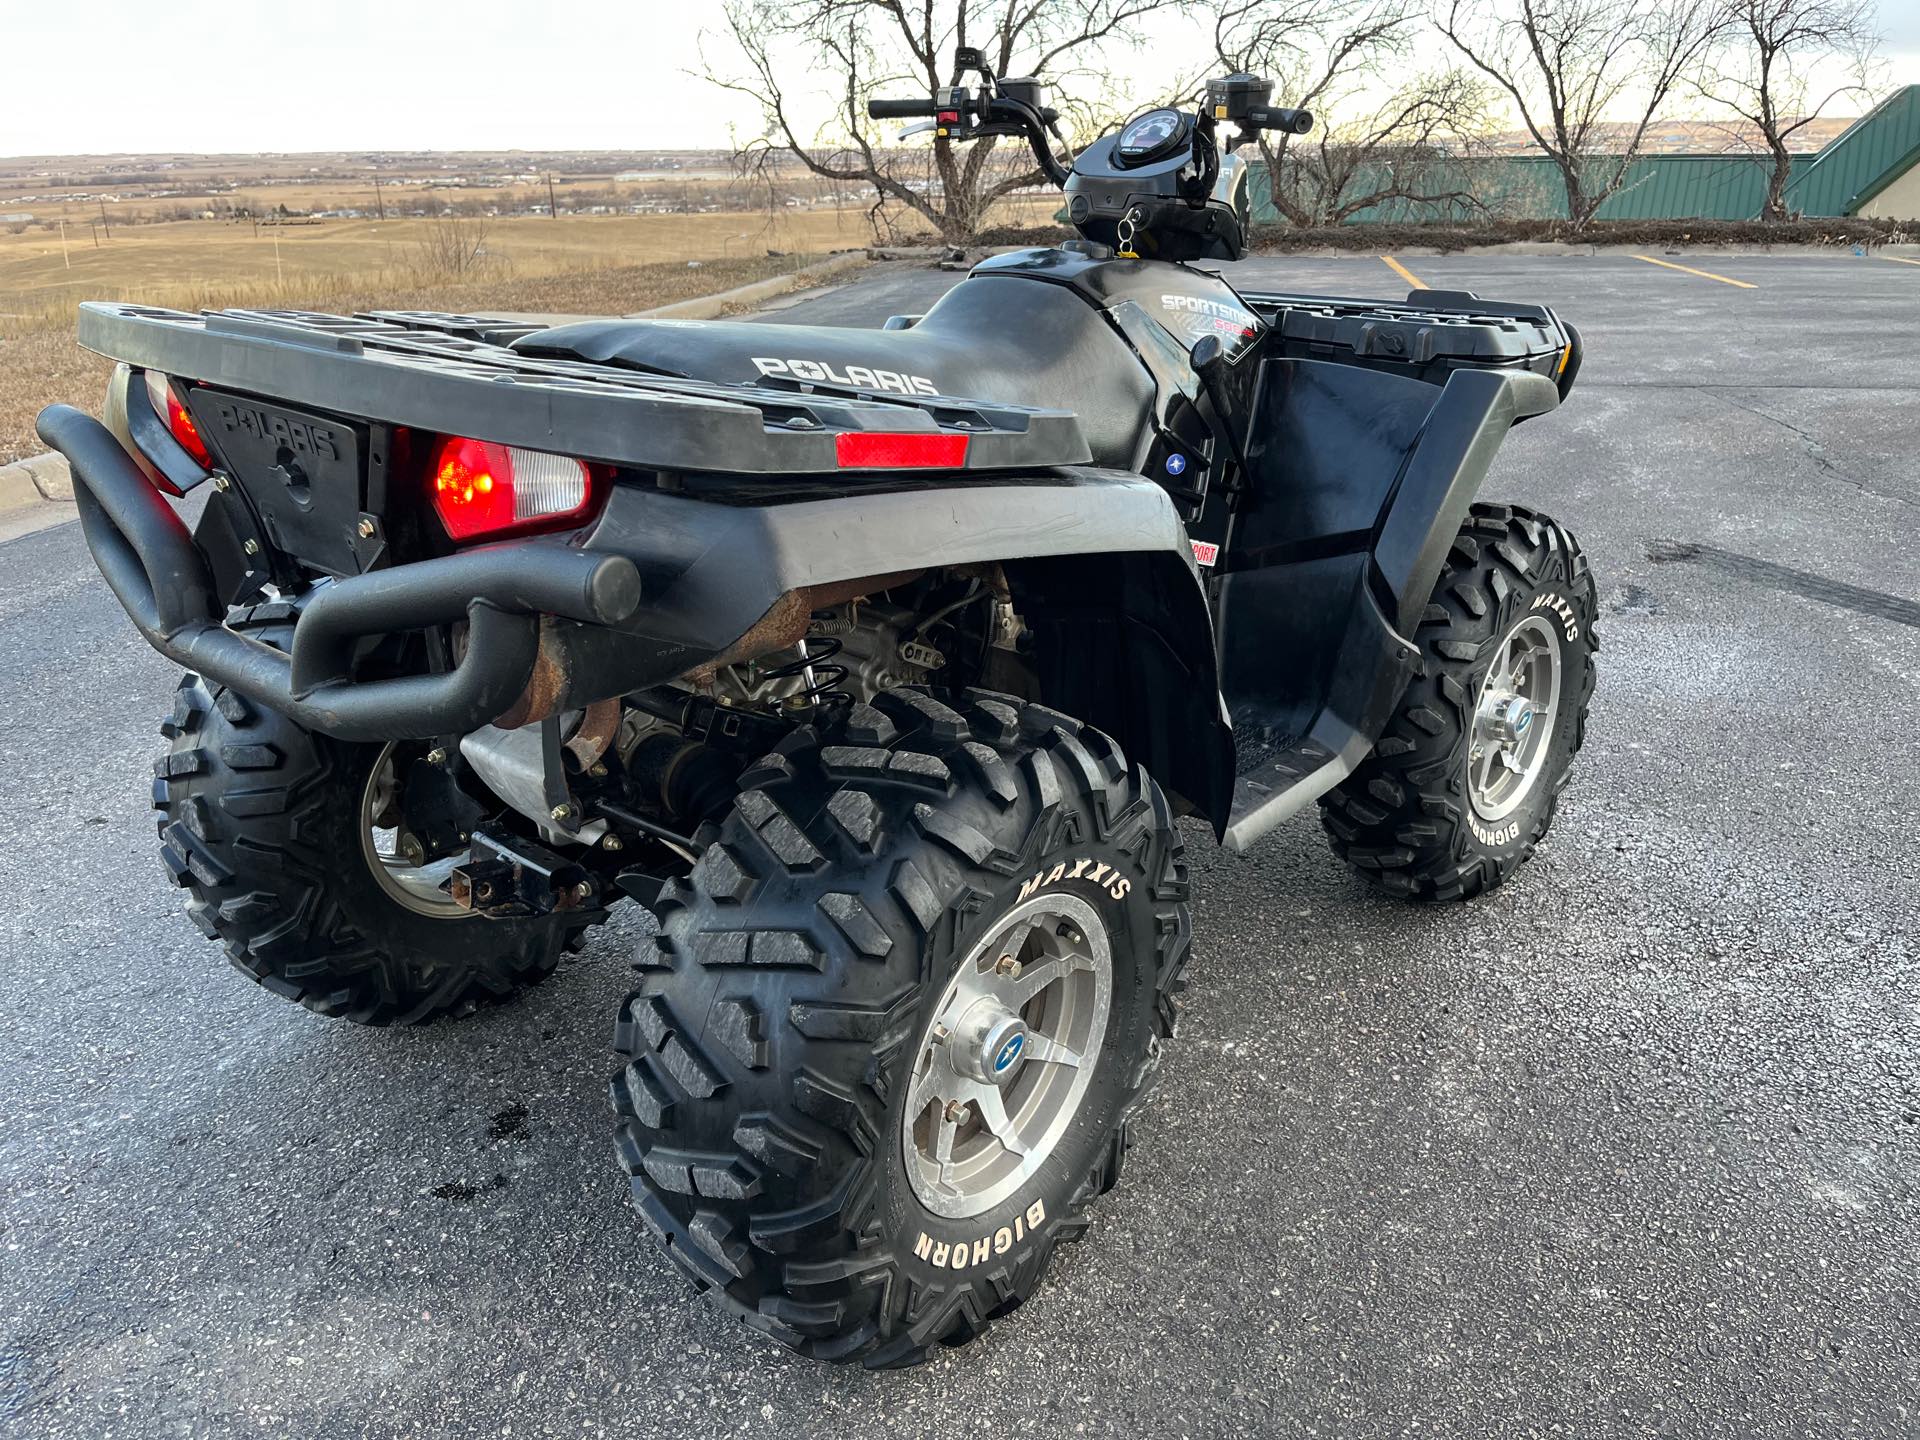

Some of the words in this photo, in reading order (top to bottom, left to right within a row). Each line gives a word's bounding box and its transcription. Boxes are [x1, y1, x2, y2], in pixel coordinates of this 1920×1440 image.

[1161, 295, 1258, 332] SPORTSMAN
[751, 357, 940, 396] POLARIS
[216, 402, 339, 461] POLARIS
[1192, 544, 1217, 563] PORT
[1529, 593, 1579, 642] MAXXIS
[1466, 809, 1520, 847] BIGHORN
[1015, 858, 1131, 904] MAXXIS
[913, 1198, 1046, 1270] BIGHORN
